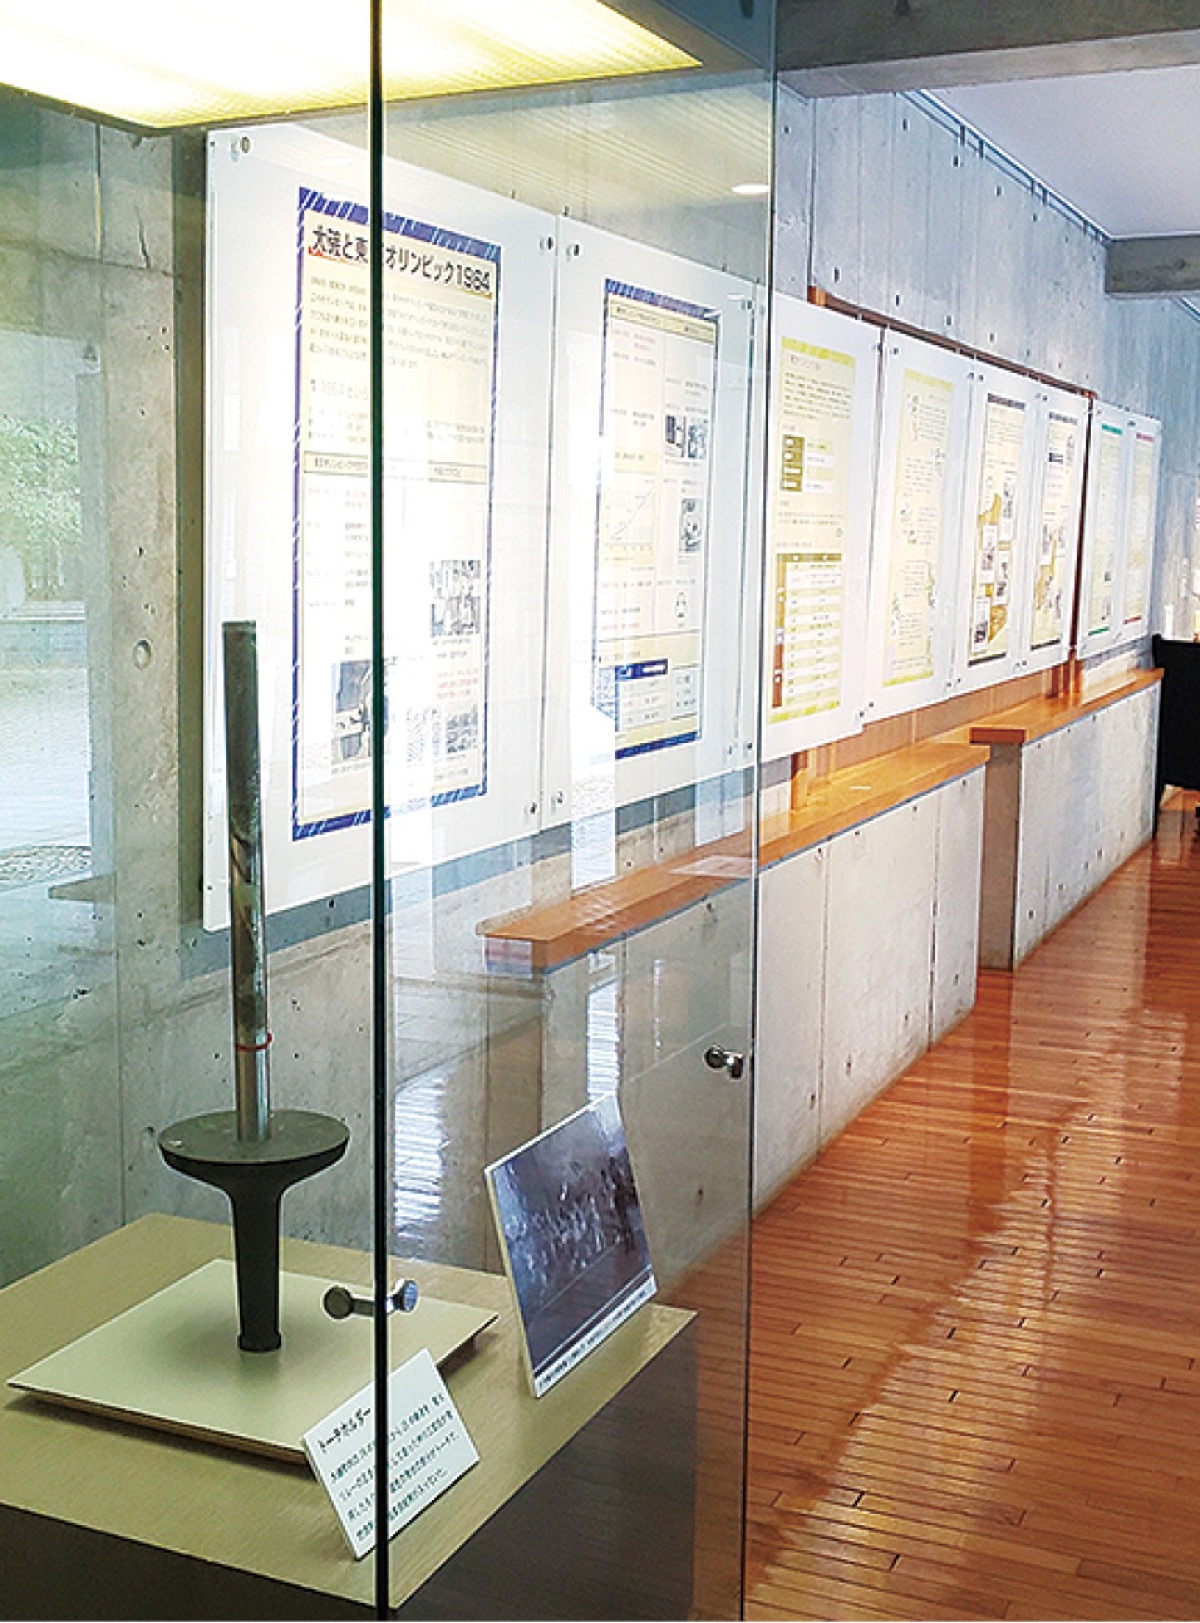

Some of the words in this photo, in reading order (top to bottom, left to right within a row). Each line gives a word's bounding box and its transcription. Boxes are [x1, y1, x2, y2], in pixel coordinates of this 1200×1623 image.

[312, 225, 490, 291] 大磯と東オリンピック1964
